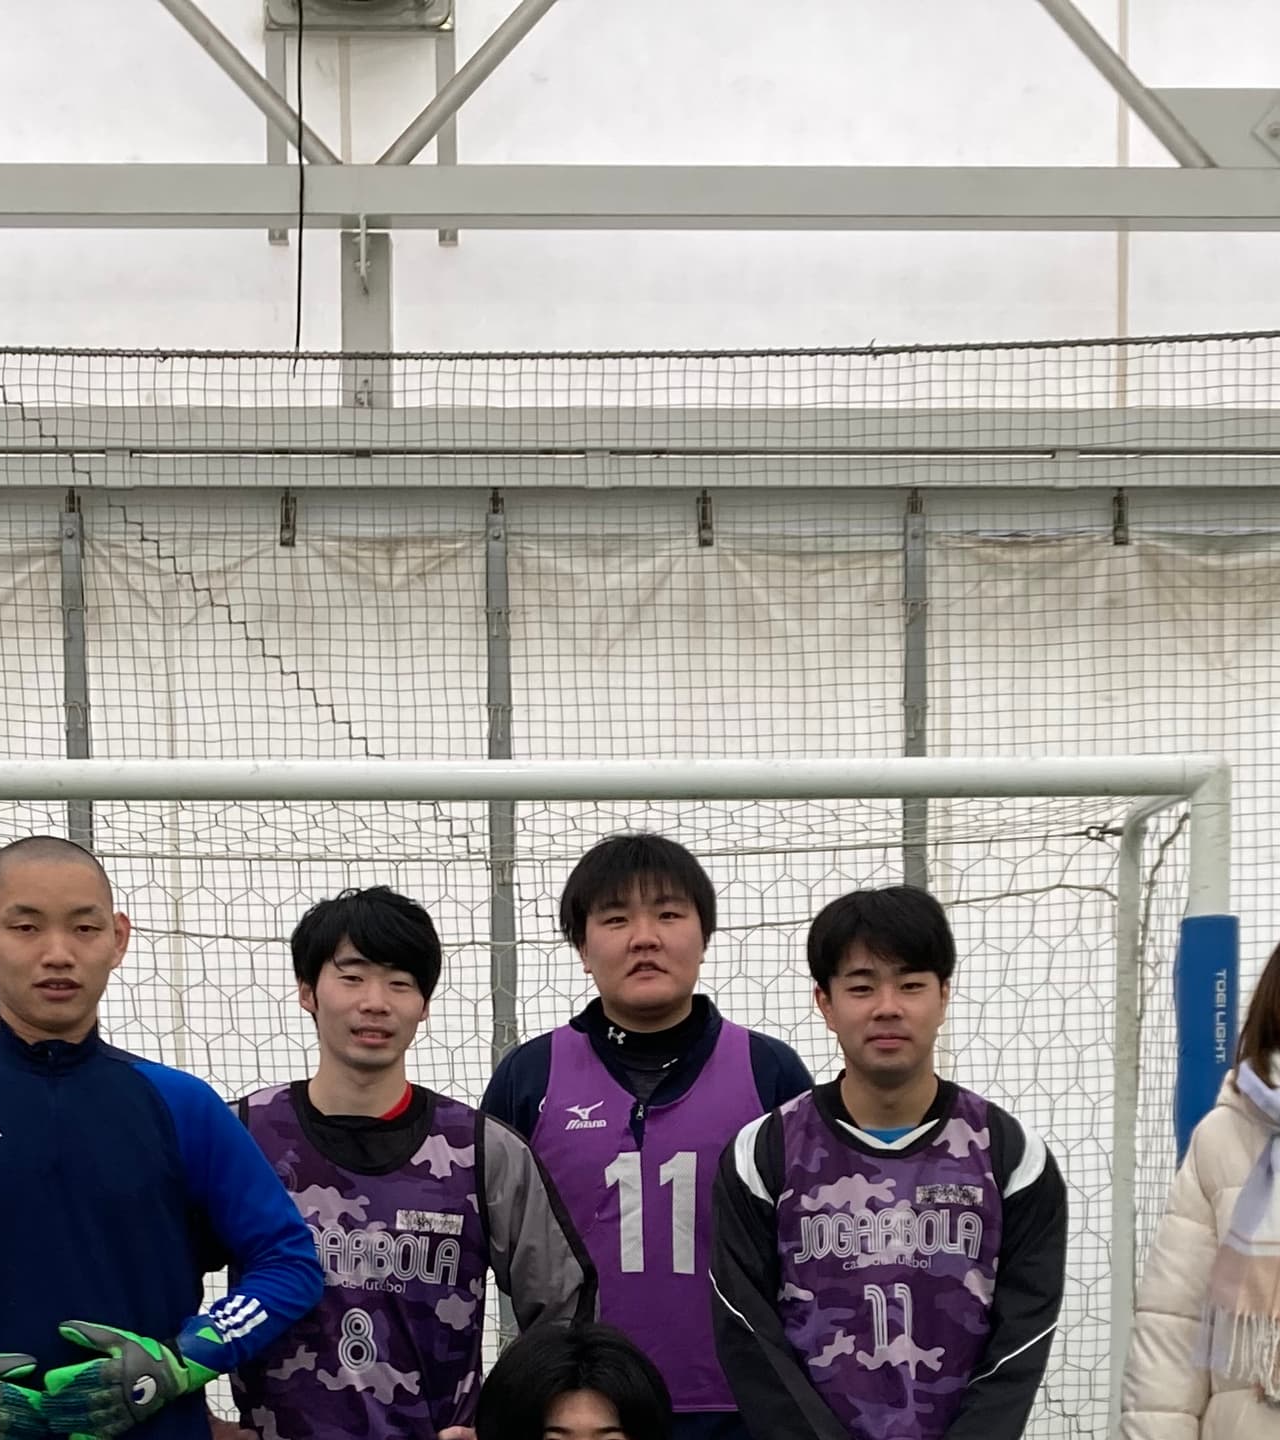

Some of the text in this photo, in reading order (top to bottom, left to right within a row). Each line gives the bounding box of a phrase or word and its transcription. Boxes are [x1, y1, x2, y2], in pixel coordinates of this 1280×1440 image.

[1214, 968, 1227, 1061] TOEI LIGHT
[605, 1151, 697, 1275] 11
[794, 1208, 983, 1264] JOGARBOLA
[338, 1307, 377, 1373] 8
[863, 1282, 913, 1348] 11
